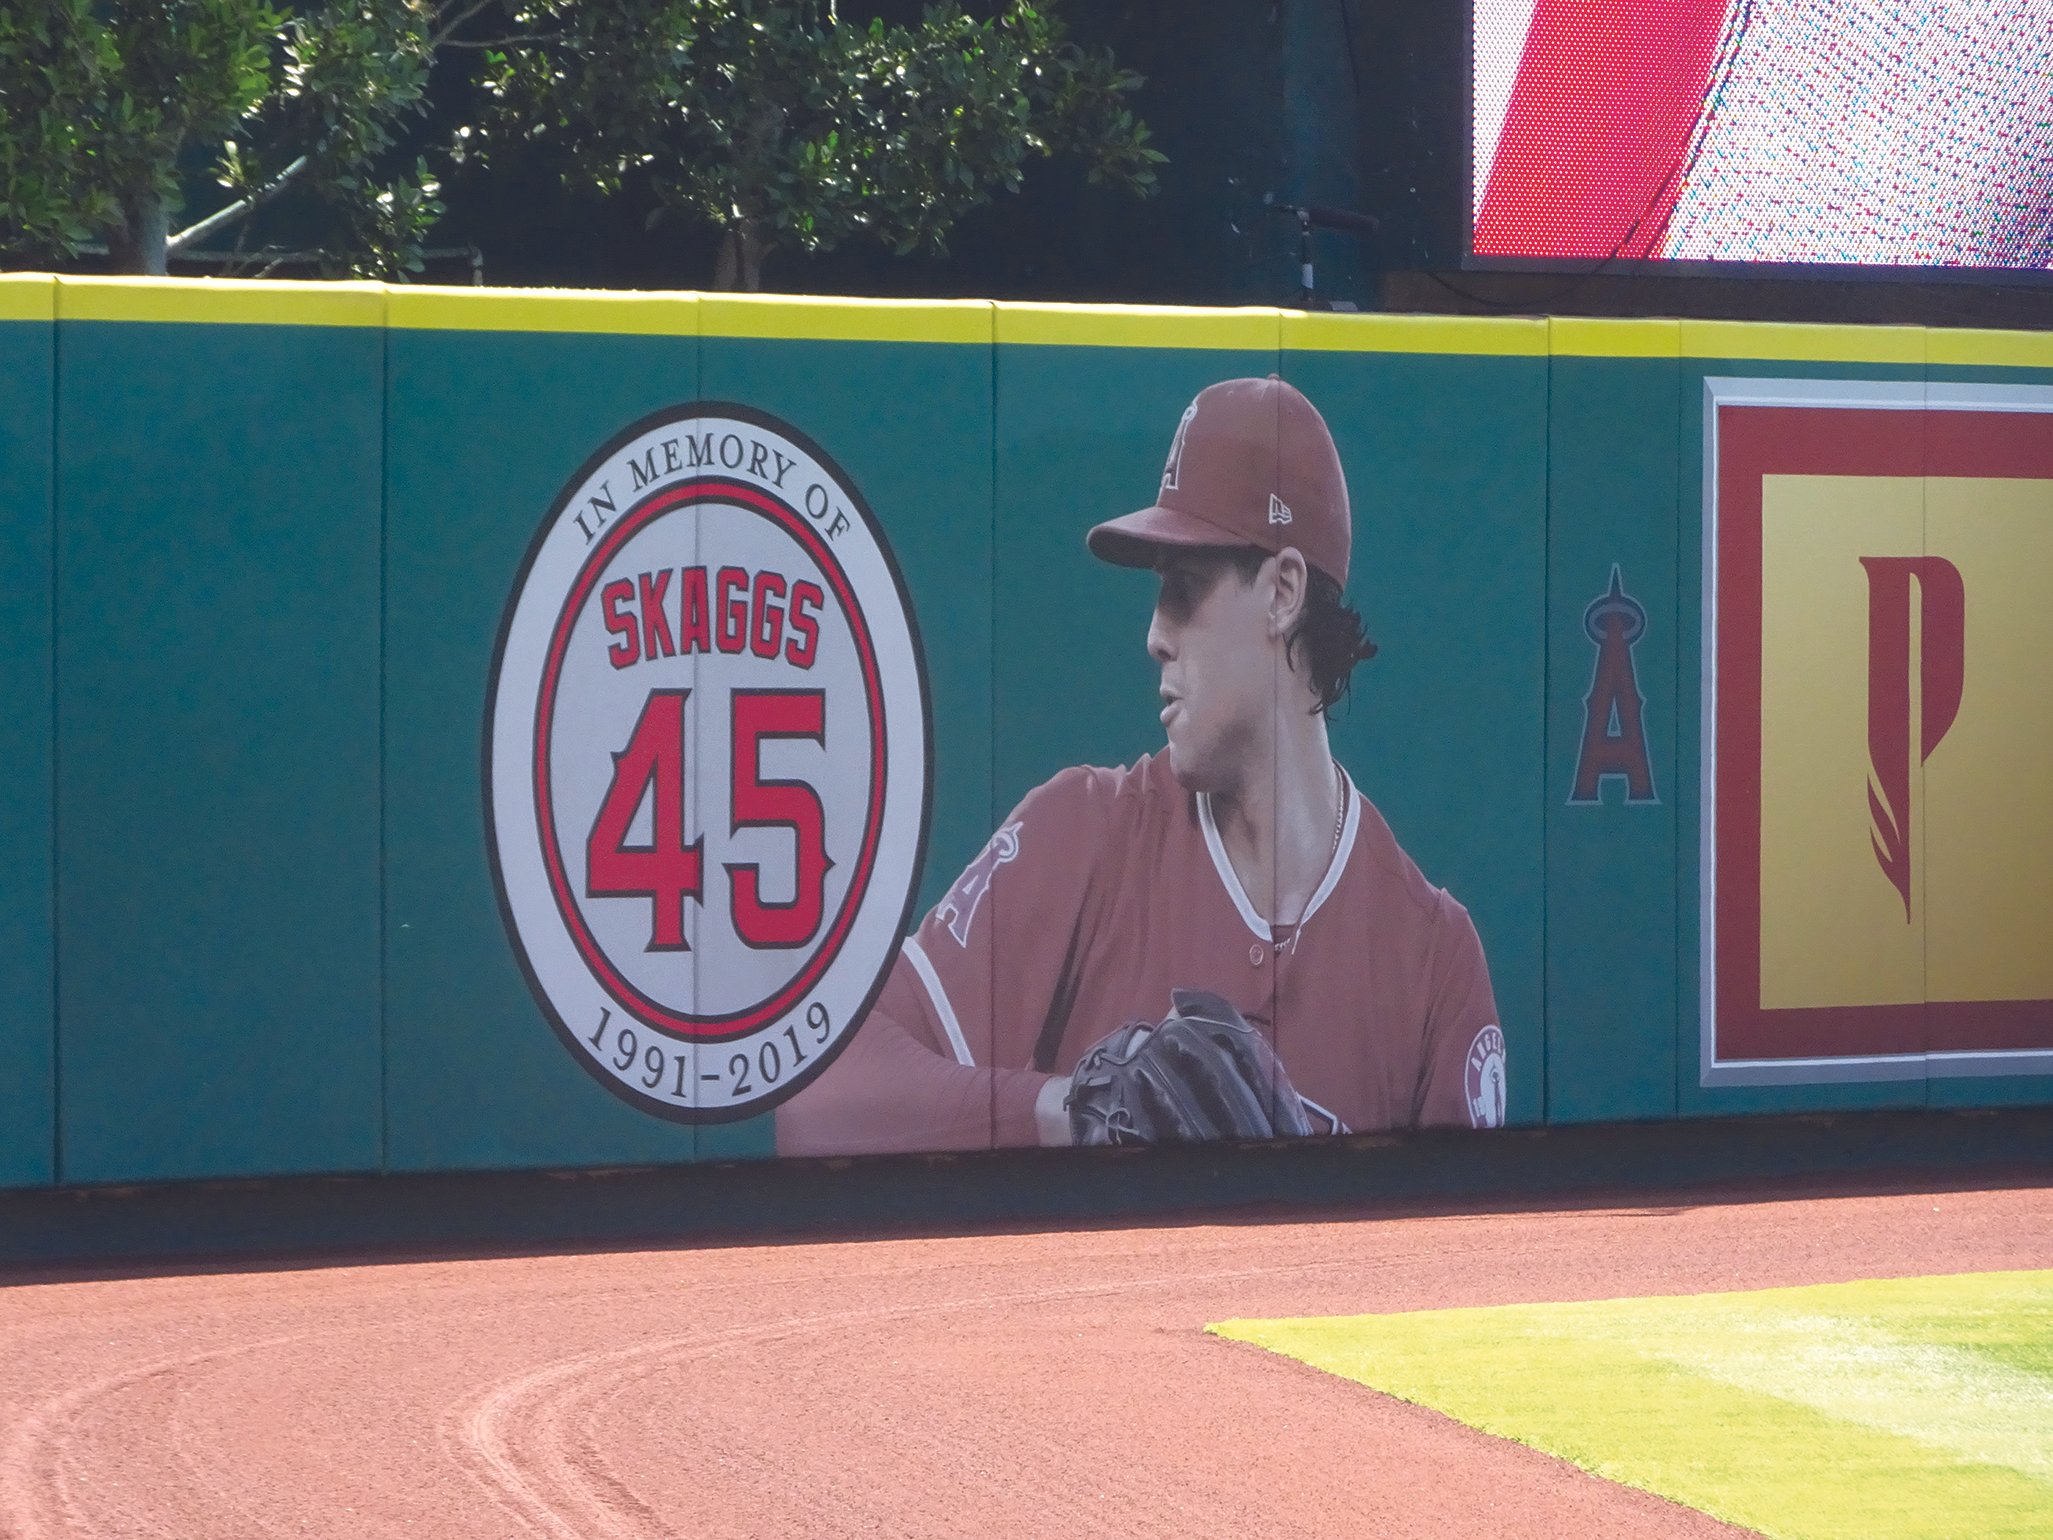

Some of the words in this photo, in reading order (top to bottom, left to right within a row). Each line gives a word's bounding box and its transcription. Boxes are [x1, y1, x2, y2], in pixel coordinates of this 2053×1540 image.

[573, 481, 617, 545] IN
[626, 432, 797, 492] MEMORY
[805, 483, 851, 541] OF
[601, 565, 824, 671] SKAGGS
[585, 687, 836, 953] 45
[588, 1001, 831, 1099] 1991-2019
